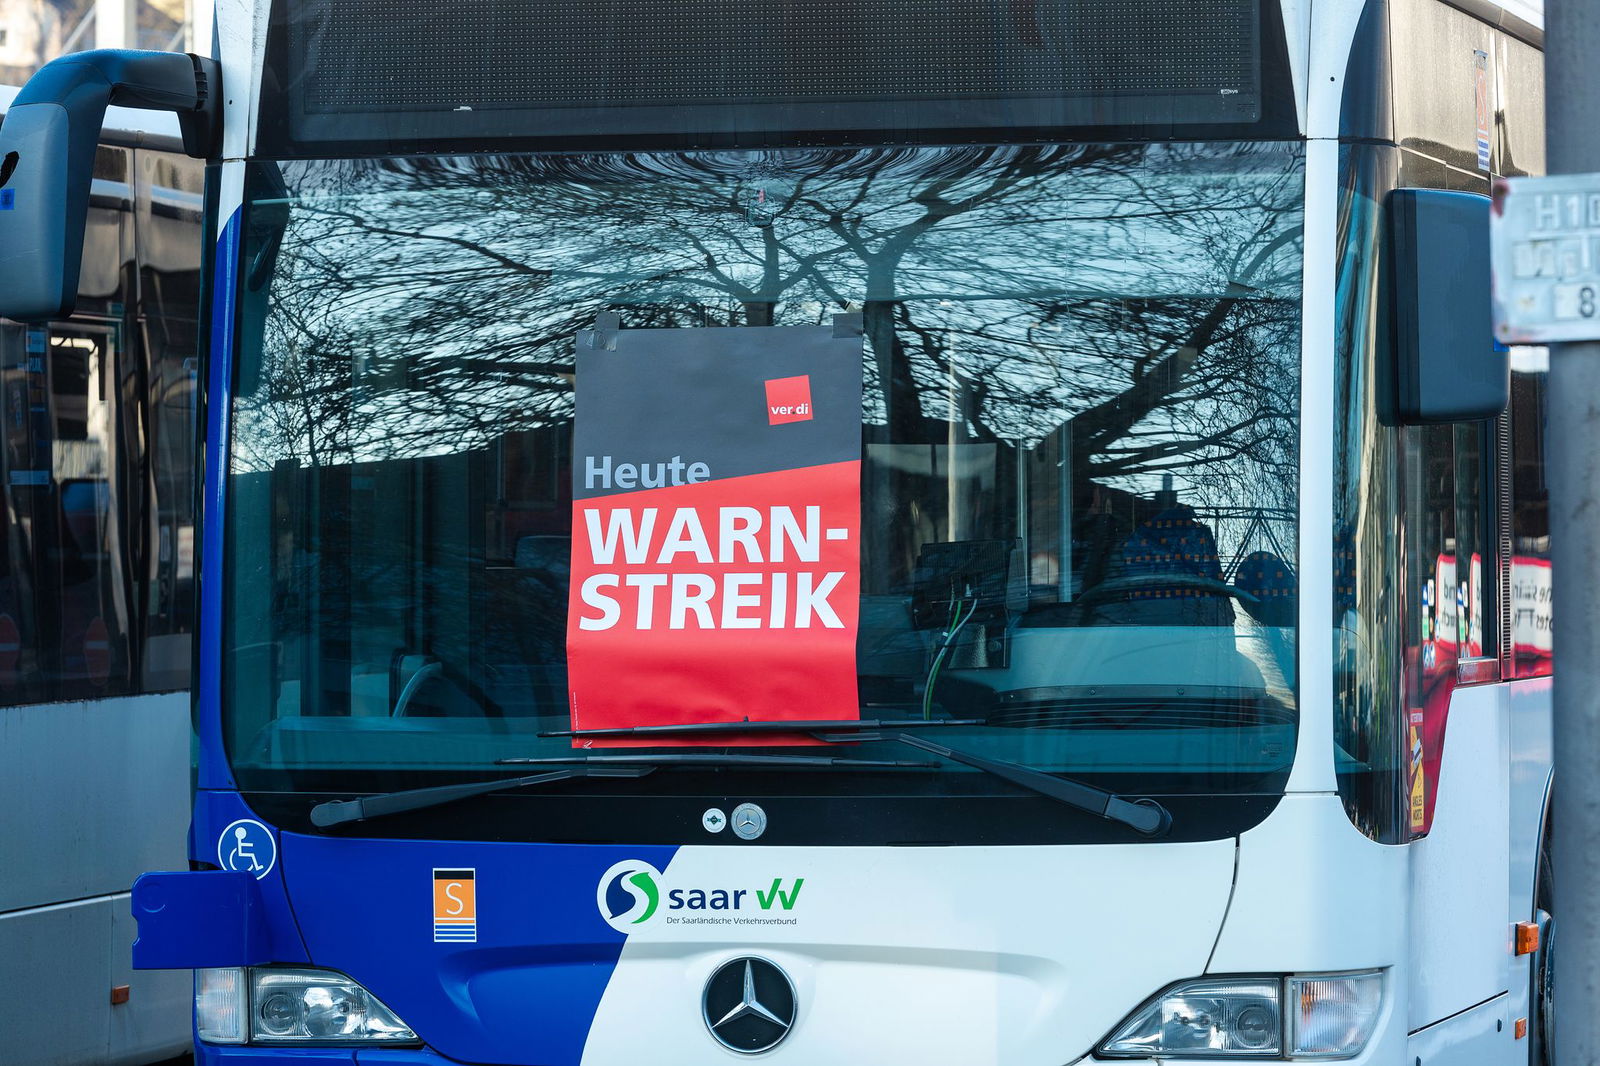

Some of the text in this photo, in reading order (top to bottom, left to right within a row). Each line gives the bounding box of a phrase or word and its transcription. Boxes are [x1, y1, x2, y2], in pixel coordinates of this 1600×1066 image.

[1577, 285, 1597, 319] 8
[770, 403, 809, 416] ver.di
[584, 455, 711, 490] Heute
[583, 505, 849, 565] WARN-
[579, 571, 846, 631] STREIK
[445, 882, 464, 915] S
[668, 888, 748, 911] saar
[666, 916, 797, 926] Der Saarländische Verkehrsverbund
